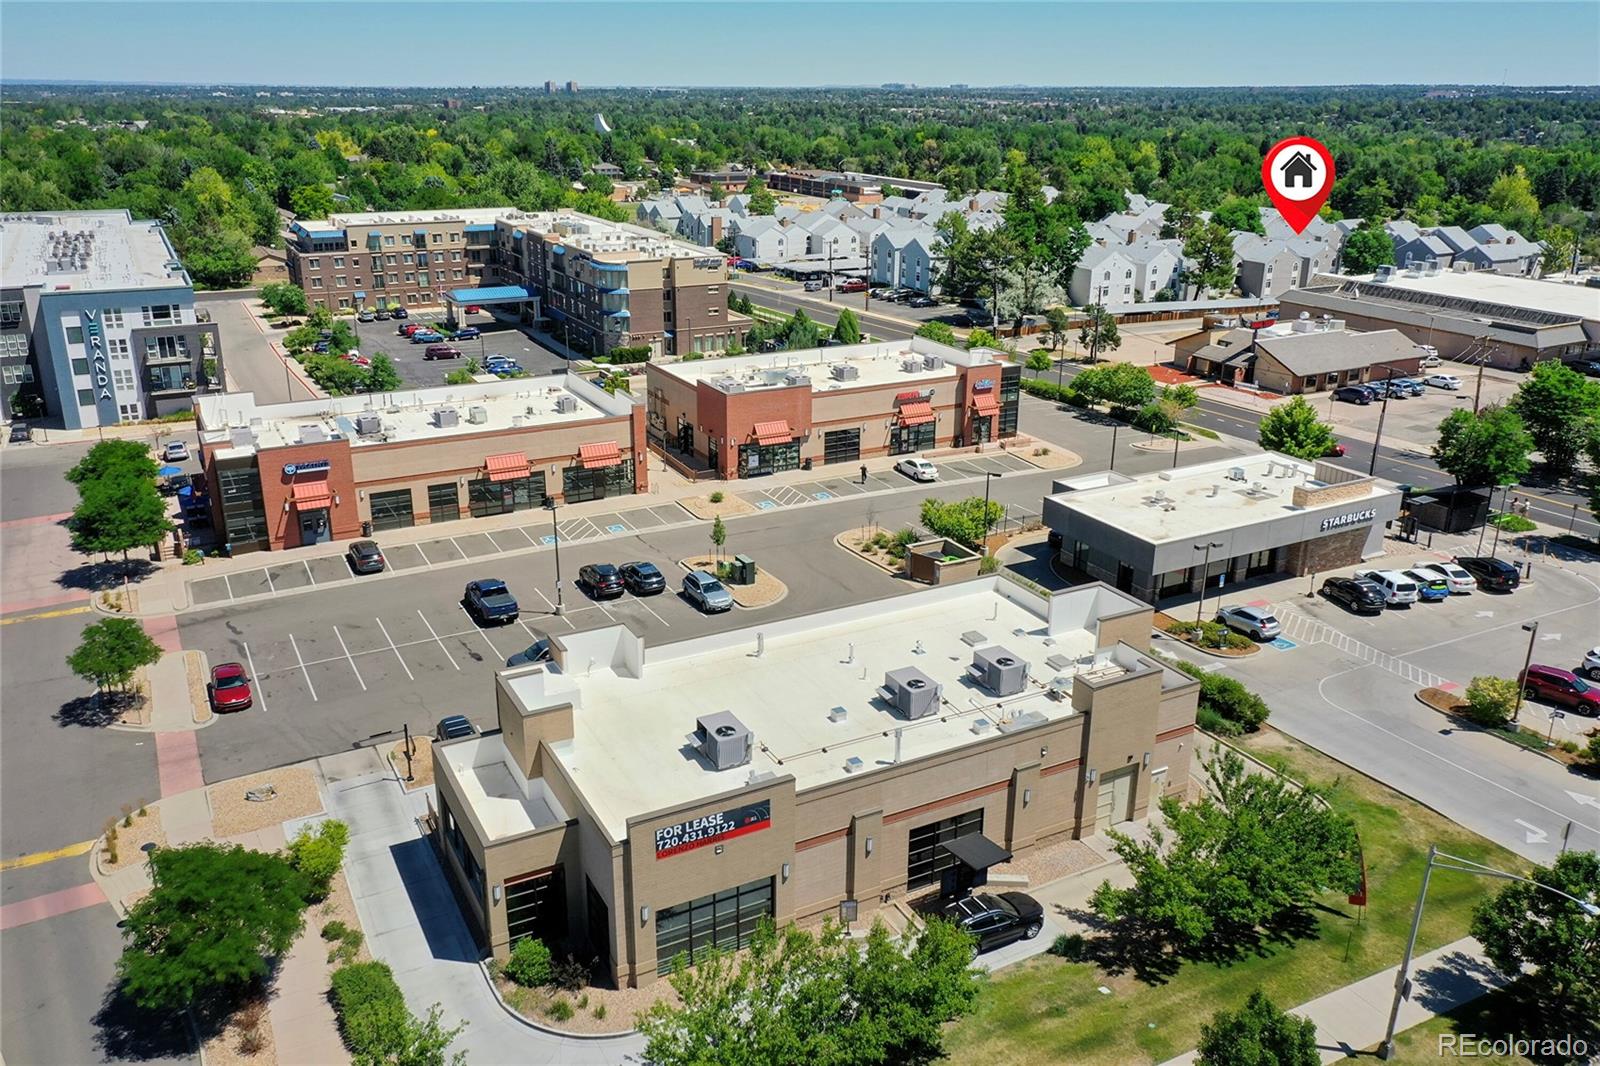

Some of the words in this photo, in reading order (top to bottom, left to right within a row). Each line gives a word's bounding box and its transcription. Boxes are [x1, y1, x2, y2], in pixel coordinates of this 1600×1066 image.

[85, 309, 112, 398] VERANDA
[1322, 509, 1377, 529] STARBUCKS
[656, 825, 682, 841] FOR
[686, 812, 724, 833] LEASE
[657, 821, 735, 851] 720.431.9122
